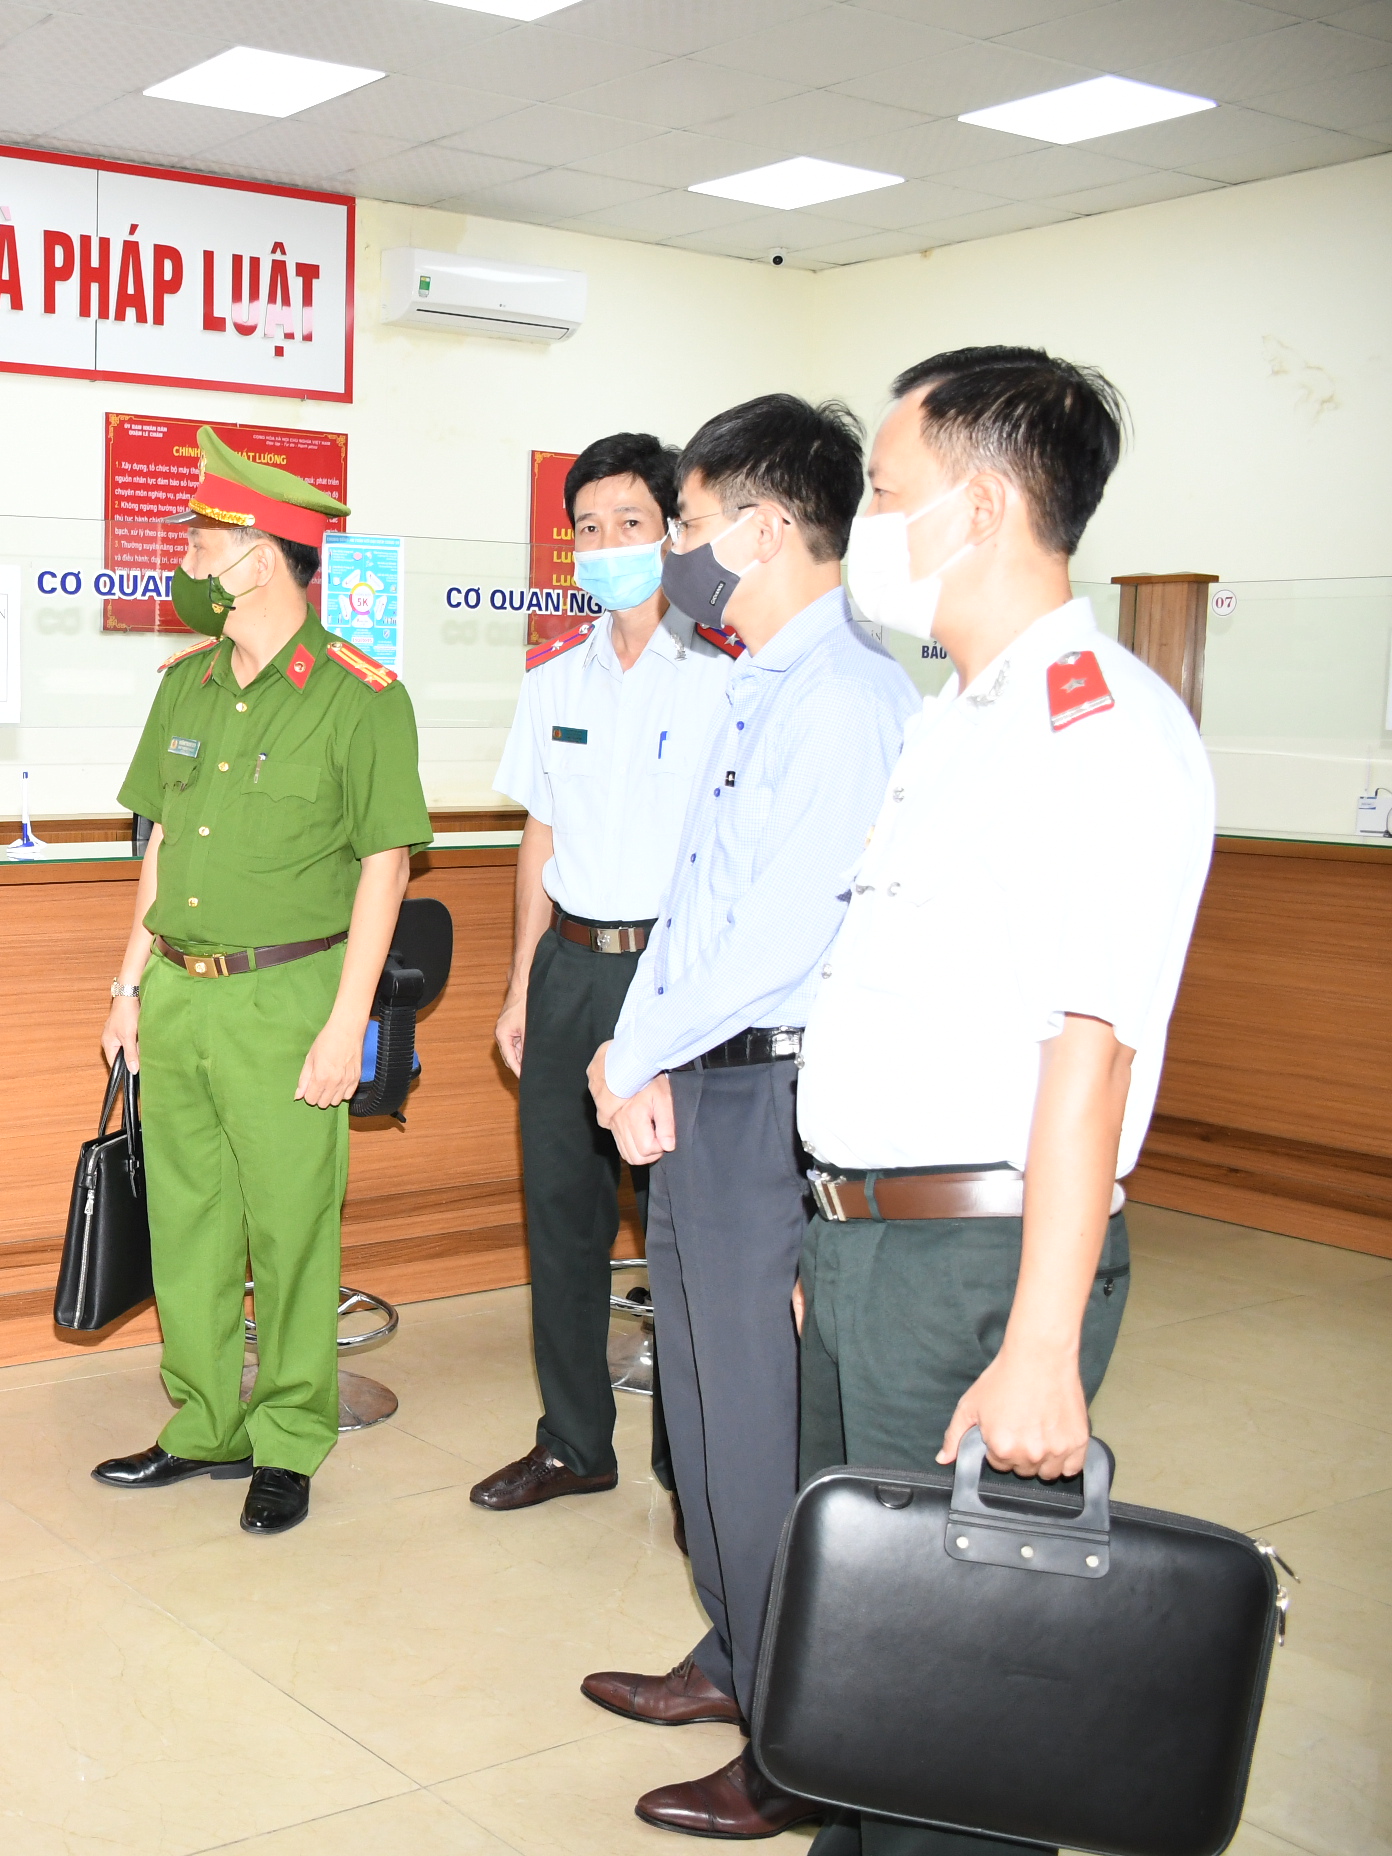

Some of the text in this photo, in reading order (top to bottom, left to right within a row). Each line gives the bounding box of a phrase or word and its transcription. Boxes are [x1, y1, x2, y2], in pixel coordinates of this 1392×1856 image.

[43, 223, 183, 327] PHÁP
[202, 241, 320, 357] LUẬT
[173, 445, 201, 457] CHÍNH
[121, 462, 131, 470] Xây
[121, 501, 138, 511] Không
[37, 570, 82, 595] CƠ
[357, 598, 369, 607] 5K
[446, 587, 481, 609] CƠ
[490, 589, 561, 613] QUAN
[1214, 596, 1233, 610] 07
